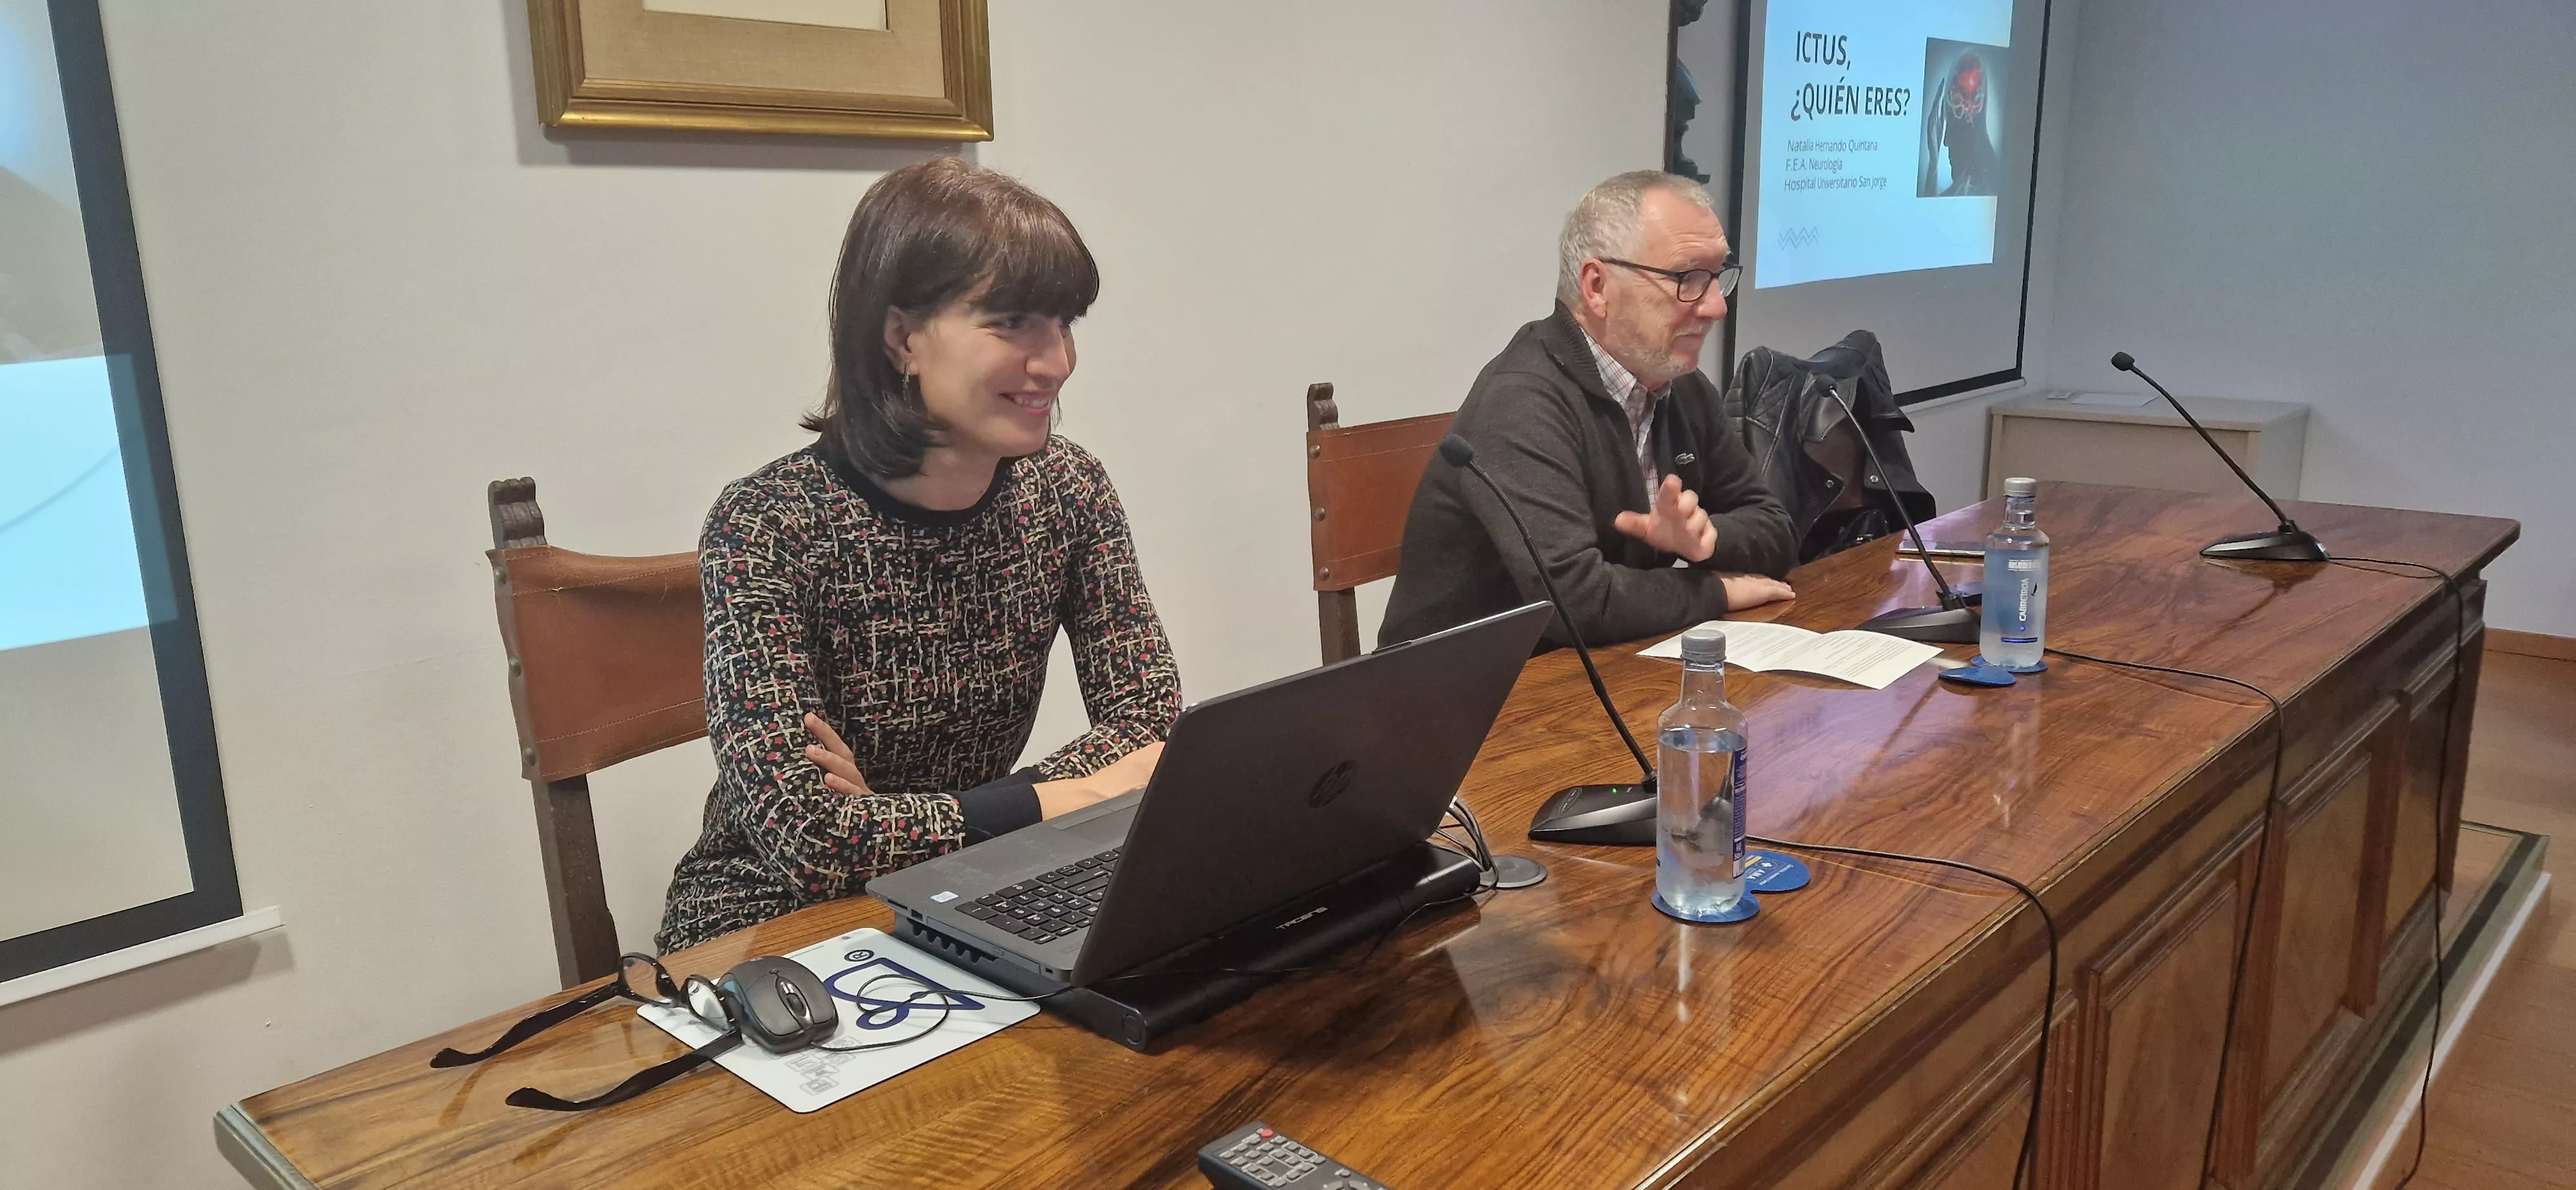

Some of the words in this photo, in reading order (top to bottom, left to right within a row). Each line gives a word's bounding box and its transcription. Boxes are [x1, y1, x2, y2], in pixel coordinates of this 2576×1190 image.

[1796, 30, 1851, 70] ICTUS,
[1790, 76, 1859, 121] ¿QUIÉN
[1865, 86, 1911, 117] ERES?
[1787, 138, 1814, 152] Natalia
[1815, 139, 1846, 152] Hernando
[1848, 139, 1878, 153] Quintana
[1786, 158, 1806, 171] F.E.A.
[1809, 158, 1842, 174] Neurología
[1785, 176, 1815, 193] Hospital
[1817, 176, 1857, 189] Universitario
[1859, 175, 1871, 187] San
[1871, 176, 1888, 190] Jorge
